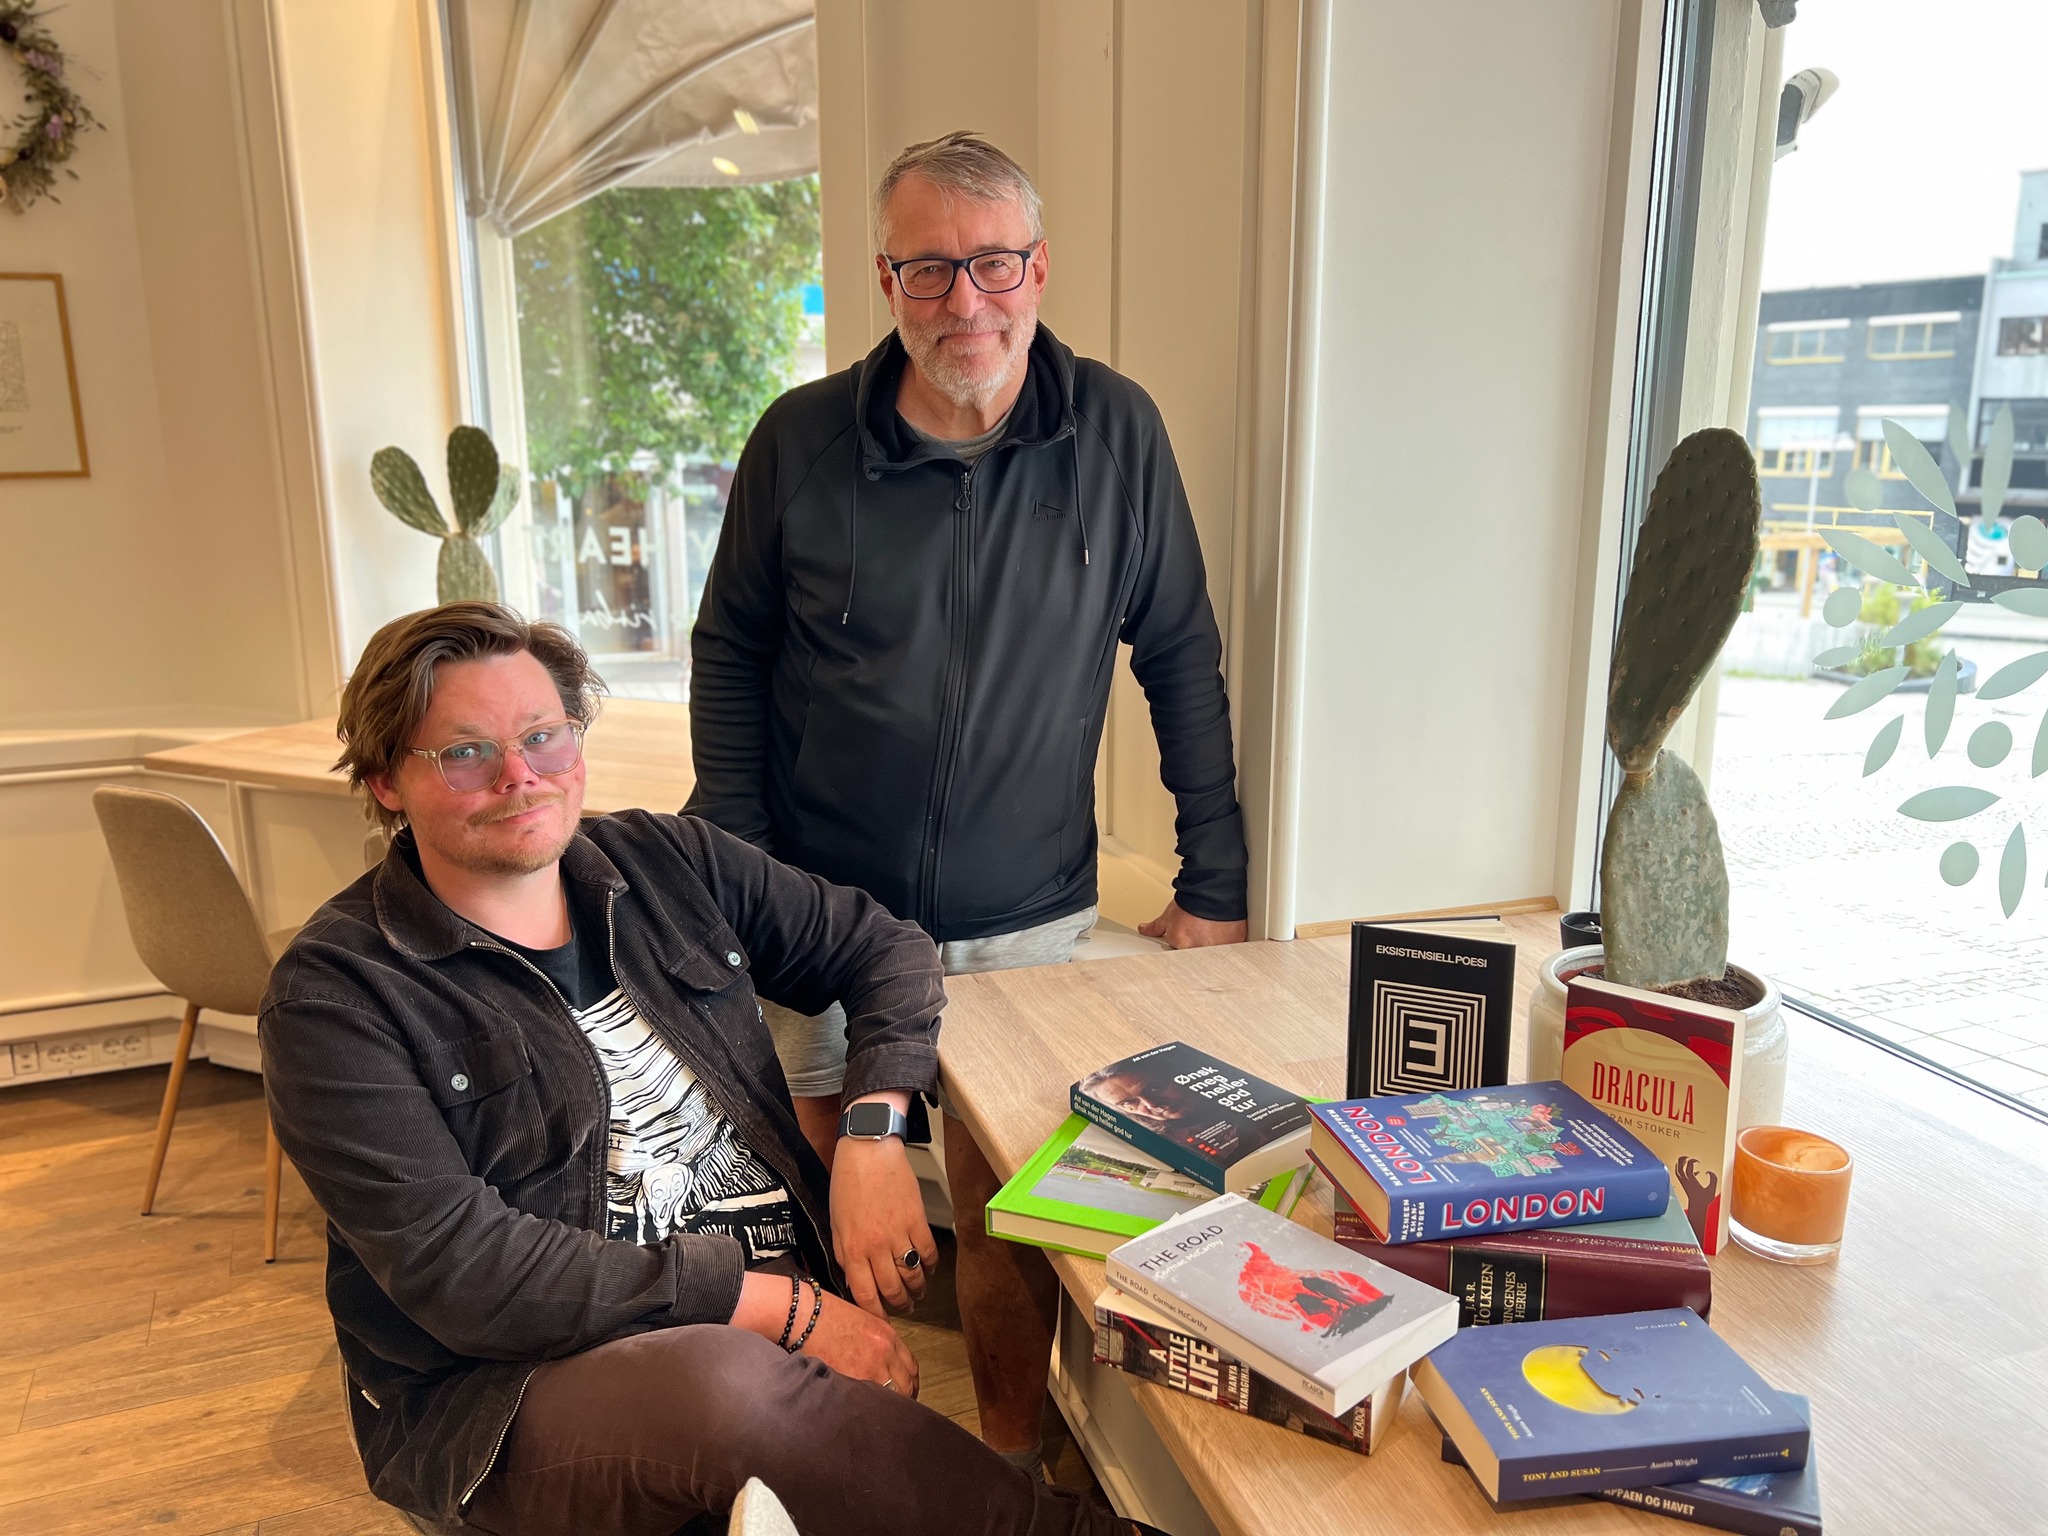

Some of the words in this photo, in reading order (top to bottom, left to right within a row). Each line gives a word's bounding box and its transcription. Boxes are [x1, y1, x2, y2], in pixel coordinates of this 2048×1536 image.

[1173, 1066, 1219, 1085] Ønsk
[1188, 1074, 1229, 1092] meg
[1200, 1077, 1248, 1099] heller
[1591, 1060, 1694, 1125] DRACULA
[1081, 1099, 1091, 1109] van
[1090, 1103, 1100, 1113] der
[1100, 1108, 1117, 1123] Hagen
[1218, 1088, 1251, 1107] god
[1230, 1098, 1258, 1113] tur
[1074, 1102, 1087, 1114] Ønsk
[1087, 1110, 1099, 1122] meg
[1099, 1116, 1114, 1129] heller
[1113, 1125, 1124, 1135] god
[1124, 1130, 1133, 1140] tur
[1604, 1111, 1633, 1127] RAM
[1636, 1120, 1681, 1139] STOKER
[1340, 1105, 1438, 1185] LONDON
[1368, 1153, 1404, 1187] NAZNEEN
[1400, 1199, 1410, 1241] NAZNEEN
[1441, 1187, 1606, 1231] LONDON
[1139, 1249, 1178, 1271] THE
[1175, 1225, 1224, 1252] ROAD
[1154, 1257, 1187, 1280] Cormac
[1186, 1238, 1224, 1262] McCarthy
[1115, 1271, 1129, 1284] THE
[1129, 1279, 1149, 1296] ROAD
[1152, 1293, 1177, 1314] Cormac
[1177, 1307, 1209, 1332] McCarthy
[1472, 1262, 1494, 1328] TOLKIEN
[1503, 1271, 1516, 1325] RINGENES
[1515, 1282, 1528, 1319] HERRE
[1149, 1348, 1168, 1364] A
[1168, 1332, 1188, 1391] LITTLE
[1188, 1339, 1220, 1401] LIFE
[1227, 1364, 1239, 1393] HANYA
[1353, 1405, 1366, 1439] PICADOR
[1522, 1472, 1547, 1482] TONY
[1549, 1469, 1569, 1479] AND
[1570, 1467, 1601, 1478] SUSAN
[1650, 1460, 1674, 1469] Austin
[1674, 1457, 1698, 1468] Wright
[1599, 1488, 1643, 1504] APPAEN
[1645, 1495, 1661, 1508] OG
[1662, 1499, 1696, 1516] HAVET
